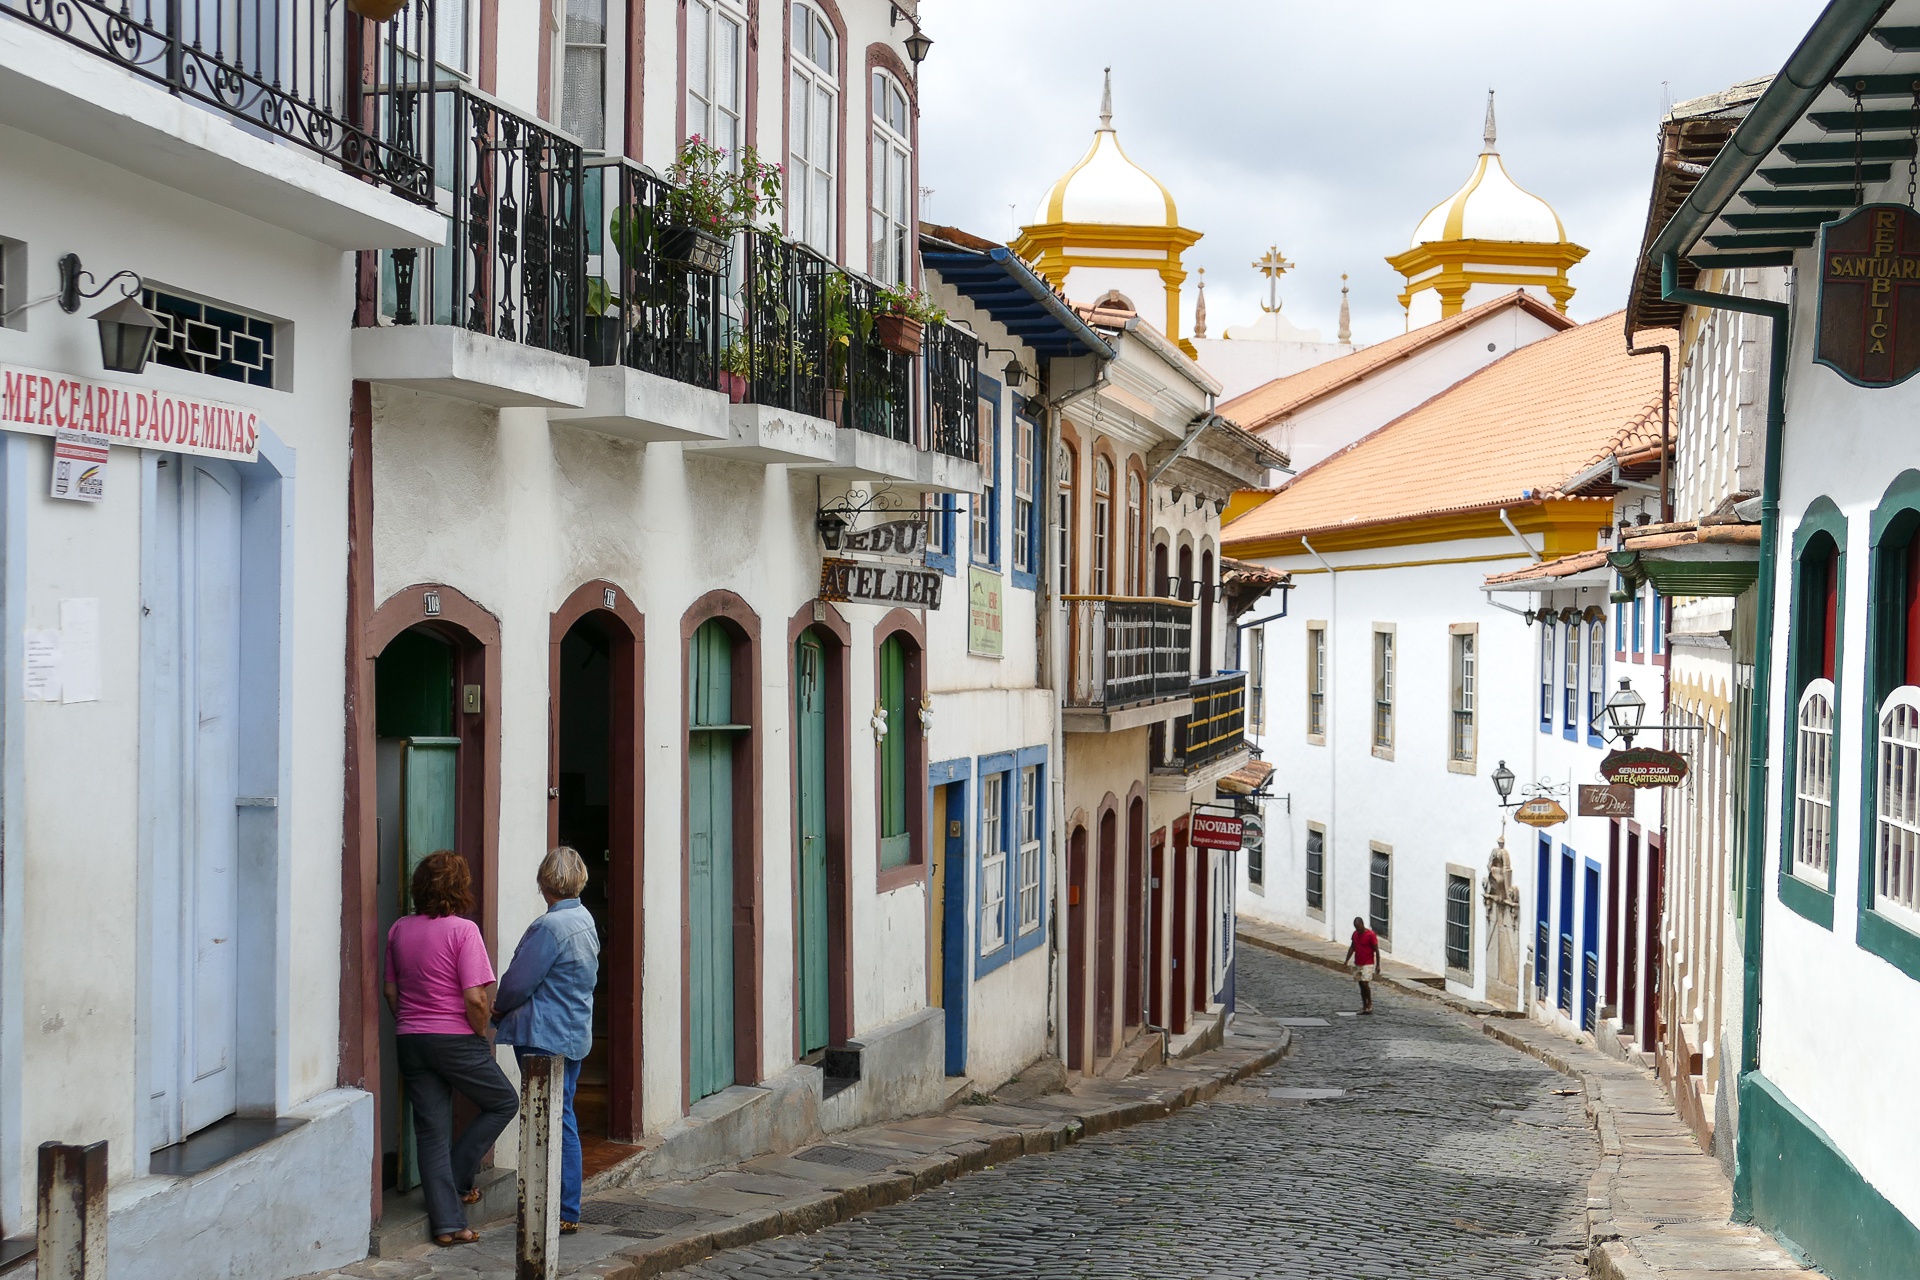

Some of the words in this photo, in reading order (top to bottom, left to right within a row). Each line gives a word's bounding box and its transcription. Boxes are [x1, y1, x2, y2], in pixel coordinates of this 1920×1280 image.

[2, 371, 131, 437] MERCEARIA
[134, 389, 175, 443] PÃO
[176, 401, 200, 446] DE
[200, 405, 257, 454] MINAS
[845, 523, 922, 553] EDU
[822, 564, 940, 610] ATELIER
[1193, 819, 1242, 835] INOVARE
